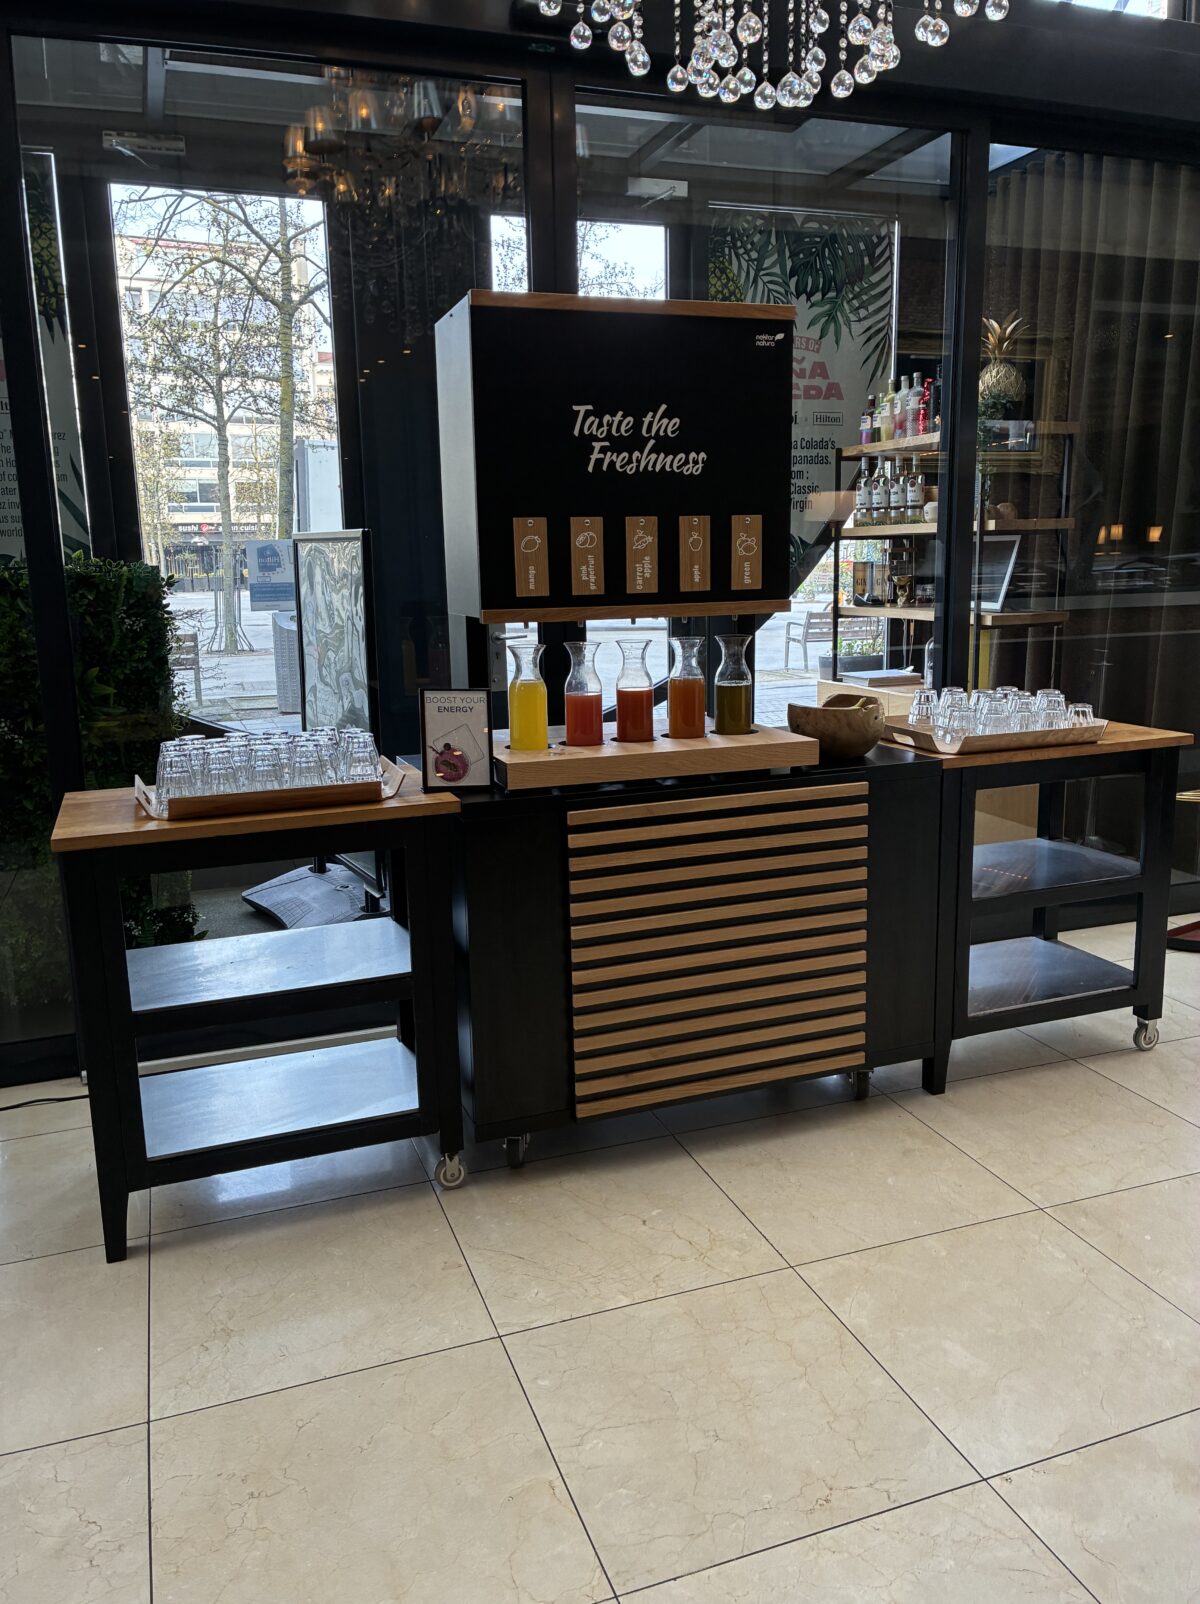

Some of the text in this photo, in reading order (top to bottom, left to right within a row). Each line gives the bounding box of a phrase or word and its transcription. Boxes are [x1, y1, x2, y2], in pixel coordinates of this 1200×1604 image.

[572, 403, 681, 439] Taste the
[815, 414, 841, 424] Hilton
[800, 437, 836, 450] Colada's
[587, 439, 708, 476] Freshness
[790, 497, 813, 512] irgin
[178, 524, 199, 532] sushi
[239, 524, 266, 532] cuisie
[528, 565, 537, 590] mango
[580, 564, 589, 581] pink
[635, 563, 643, 590] carrot
[692, 565, 701, 583] apple
[743, 561, 752, 584] green
[425, 696, 486, 704] BOOST YOUR
